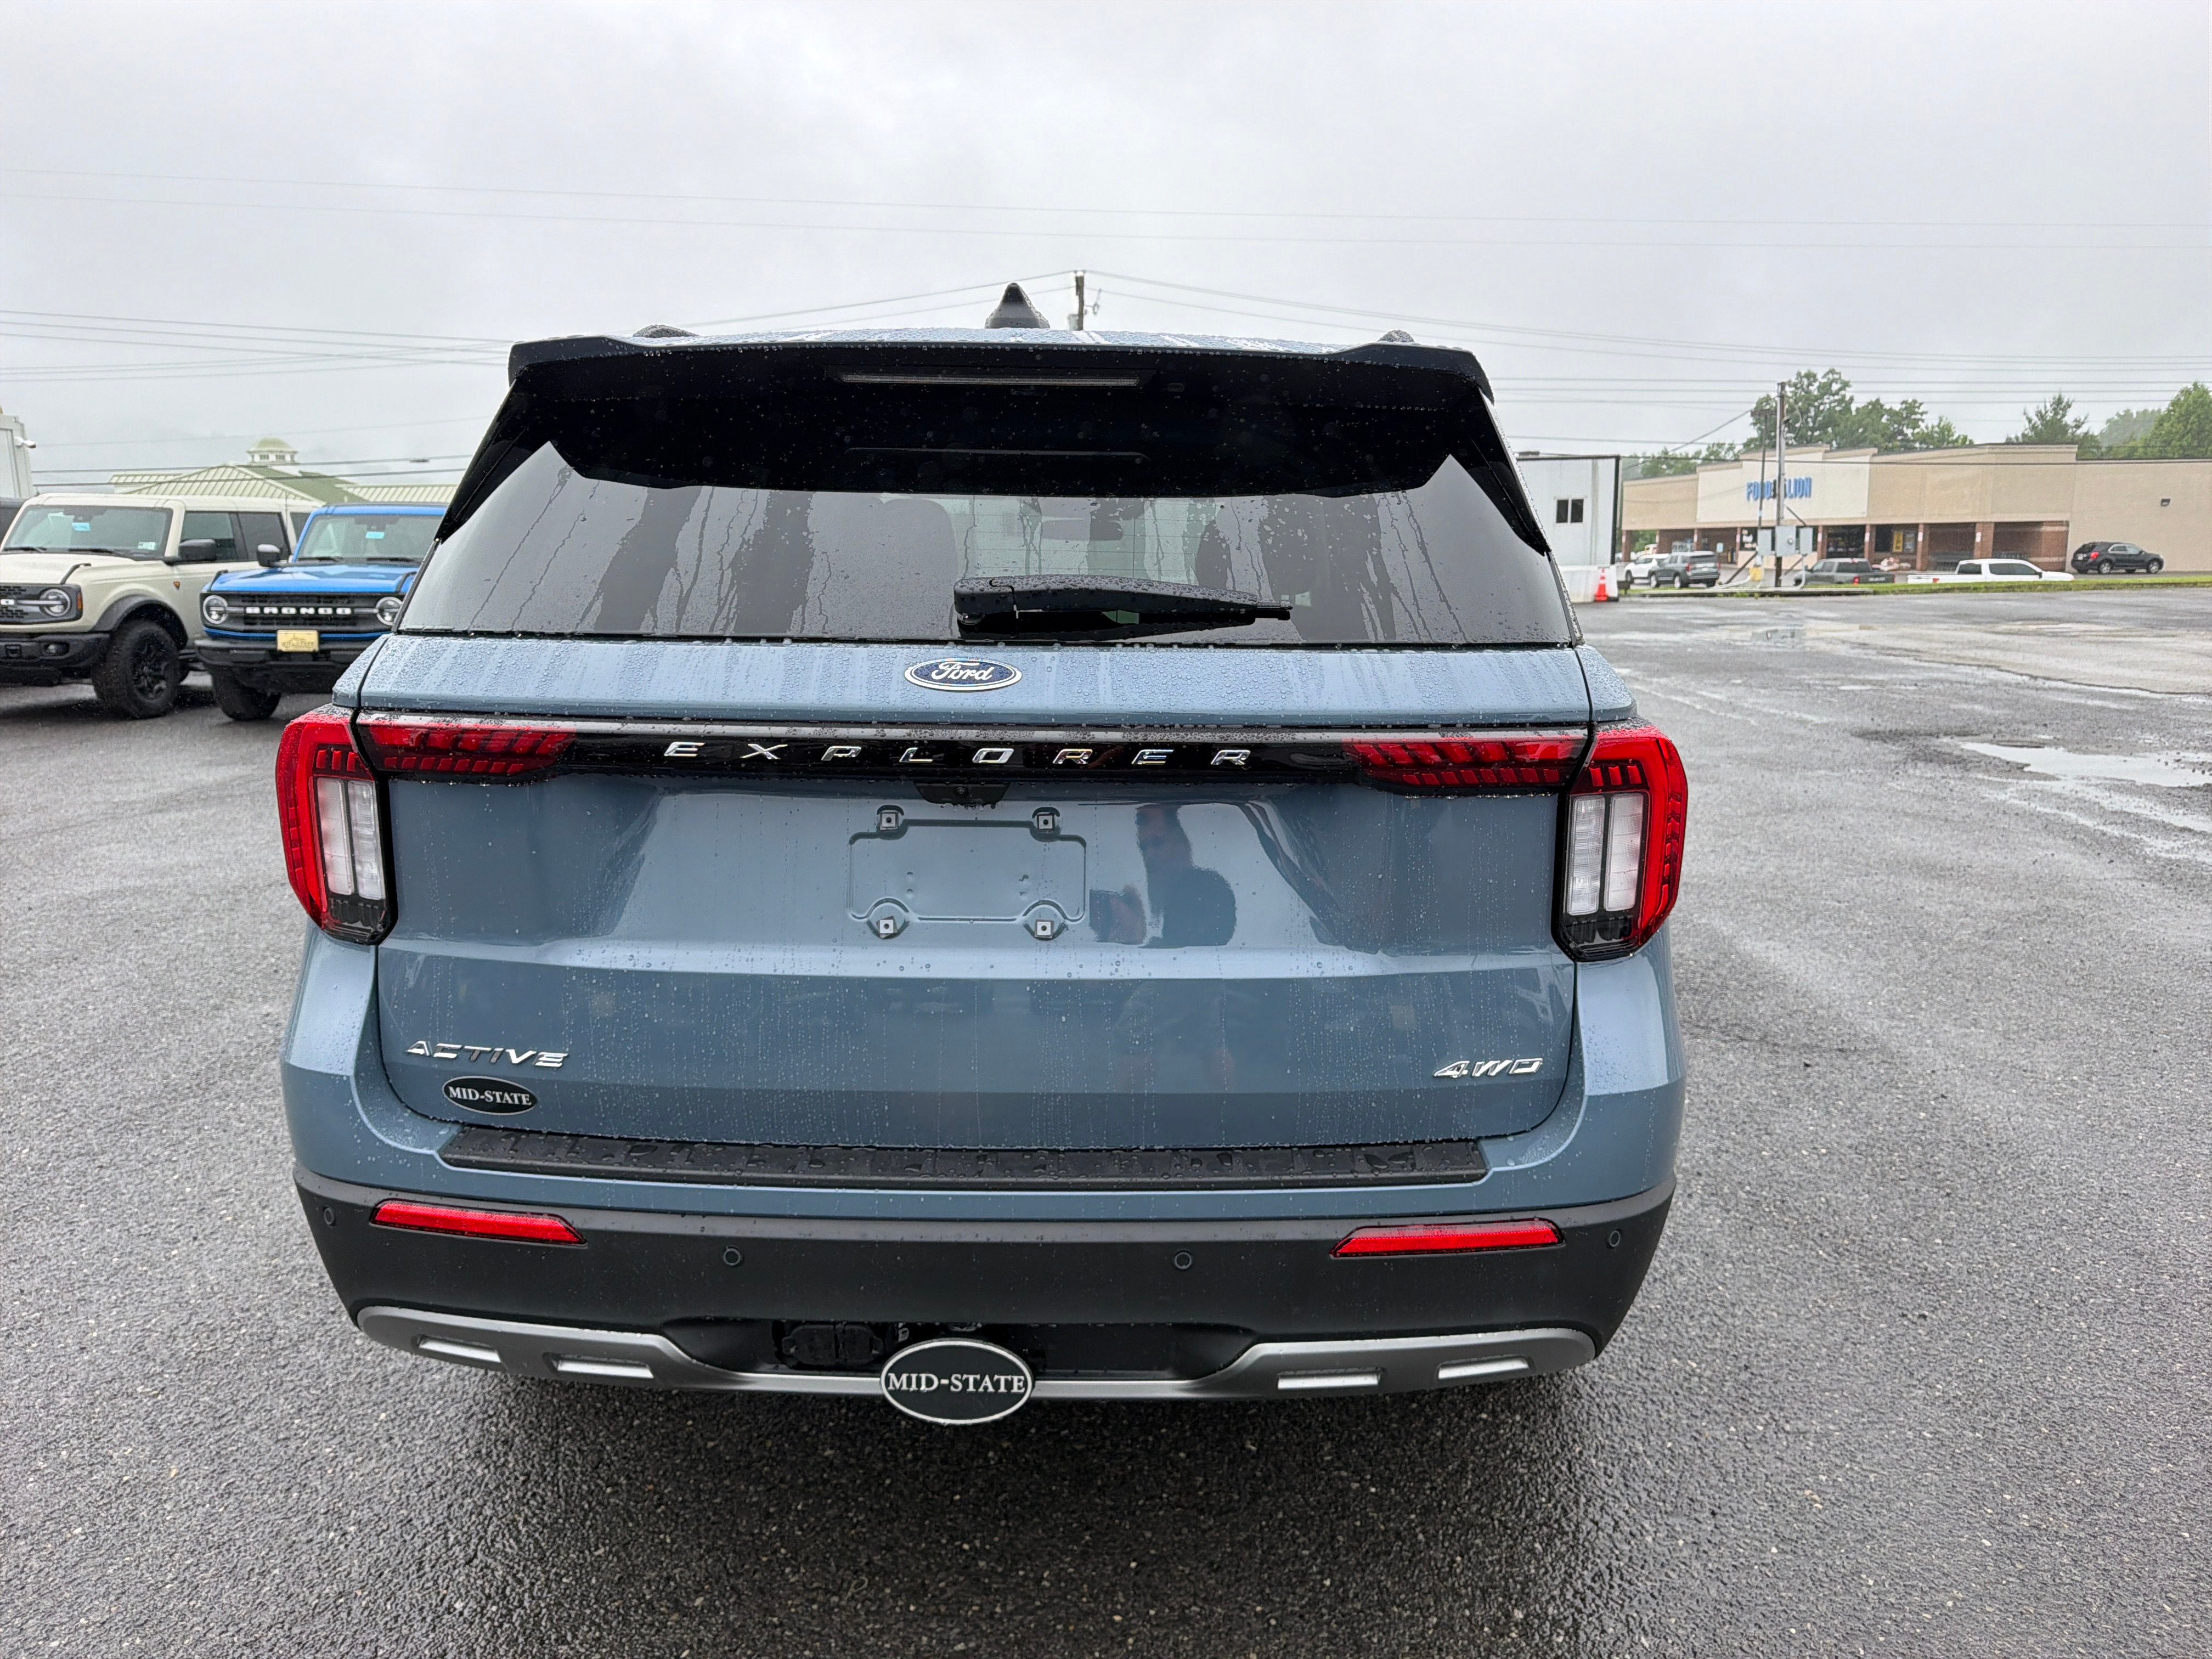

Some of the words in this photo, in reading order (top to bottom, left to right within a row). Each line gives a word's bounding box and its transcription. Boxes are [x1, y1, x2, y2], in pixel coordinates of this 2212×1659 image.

[1787, 477, 1812, 499] LION
[931, 661, 995, 680] Ford
[664, 741, 1251, 765] EXPLORER
[407, 1041, 569, 1068] ACTIVE
[1433, 1058, 1543, 1078] 4WD
[448, 1086, 532, 1106] MID-STATE
[888, 1373, 1025, 1392] MID-STATE
